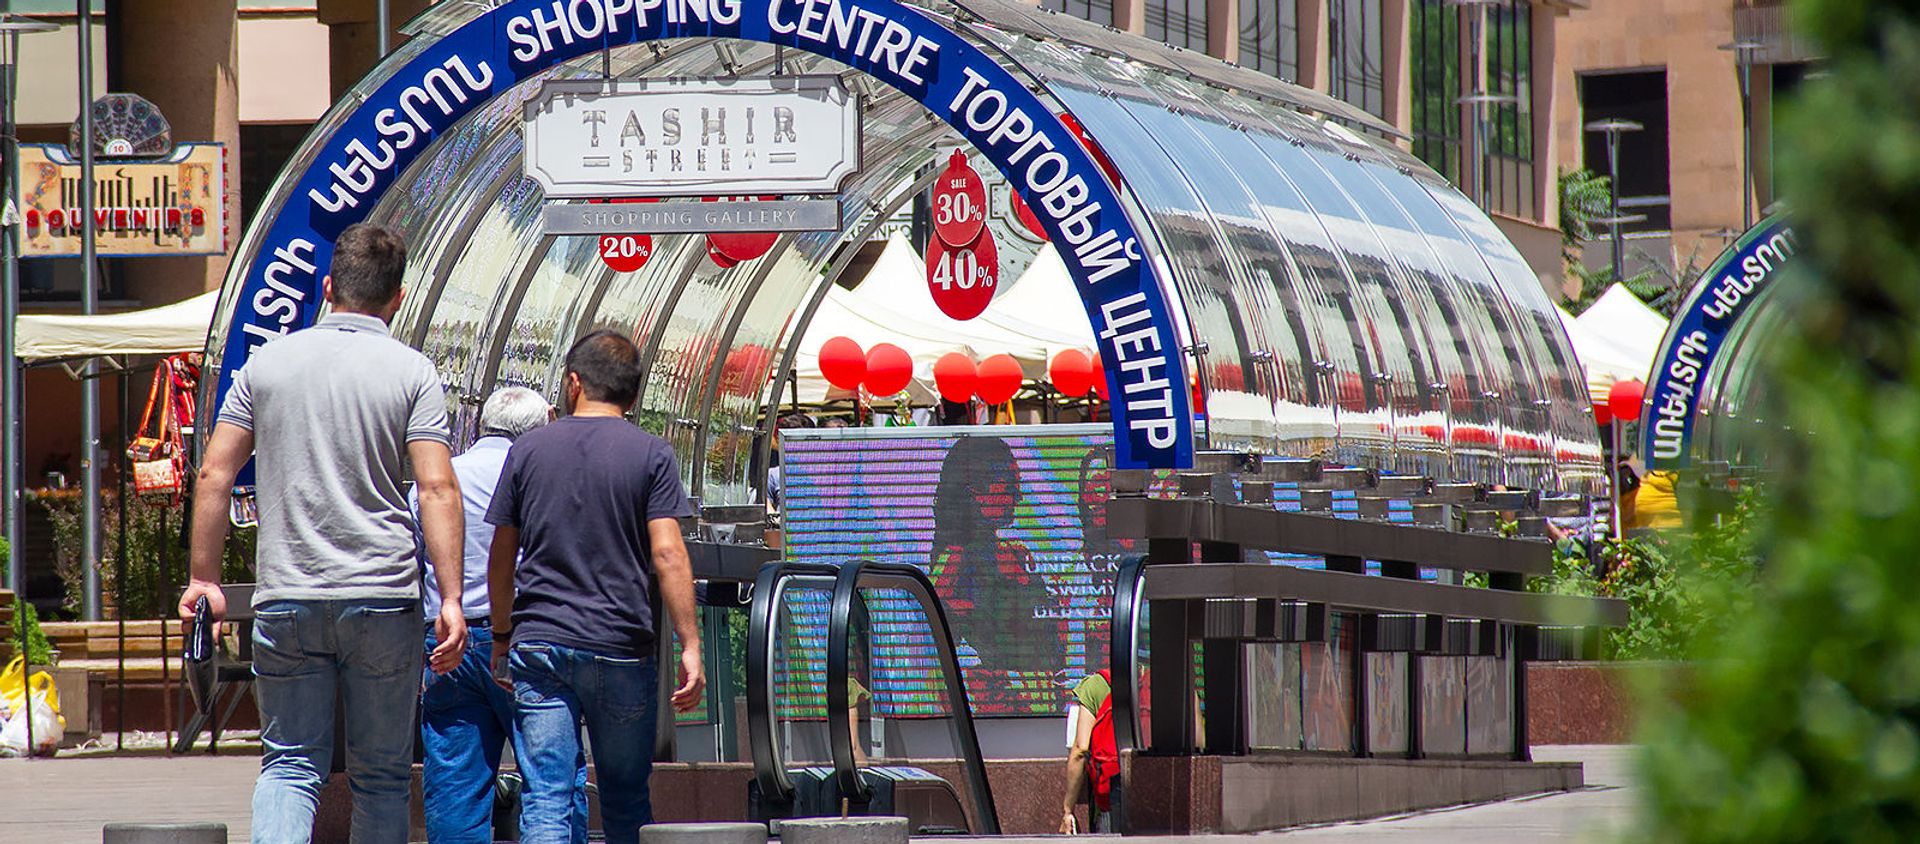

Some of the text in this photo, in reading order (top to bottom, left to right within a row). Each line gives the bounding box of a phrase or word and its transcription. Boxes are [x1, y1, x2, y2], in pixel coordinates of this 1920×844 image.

[506, 0, 940, 86] SHOPPING CENTRE
[582, 106, 797, 147] TASHIR
[622, 149, 756, 173] STREET
[950, 178, 967, 189] SALE
[26, 207, 207, 230] SOUVENIRS
[582, 209, 797, 226] SHOPPING GALLERY
[937, 192, 982, 224] 30%
[603, 237, 648, 258] 20%
[948, 66, 1178, 449] ТОРГОВЫЙ ЦЕНТР
[932, 249, 993, 291] 40%
